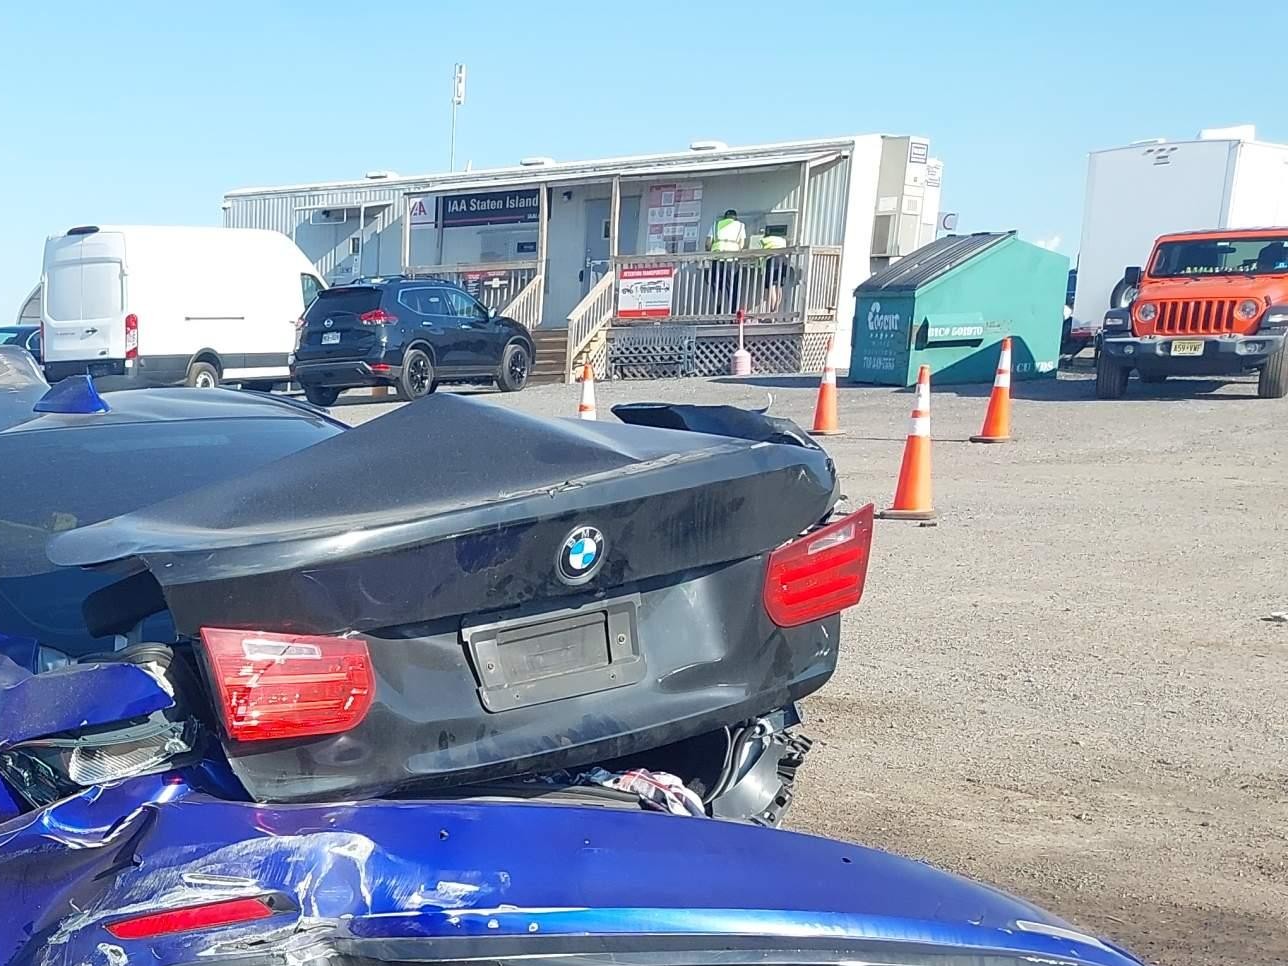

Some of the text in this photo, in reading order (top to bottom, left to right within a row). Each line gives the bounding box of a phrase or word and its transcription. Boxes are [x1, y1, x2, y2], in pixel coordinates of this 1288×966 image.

[448, 194, 539, 212] IAA Staten Island
[566, 529, 602, 549] BMW
